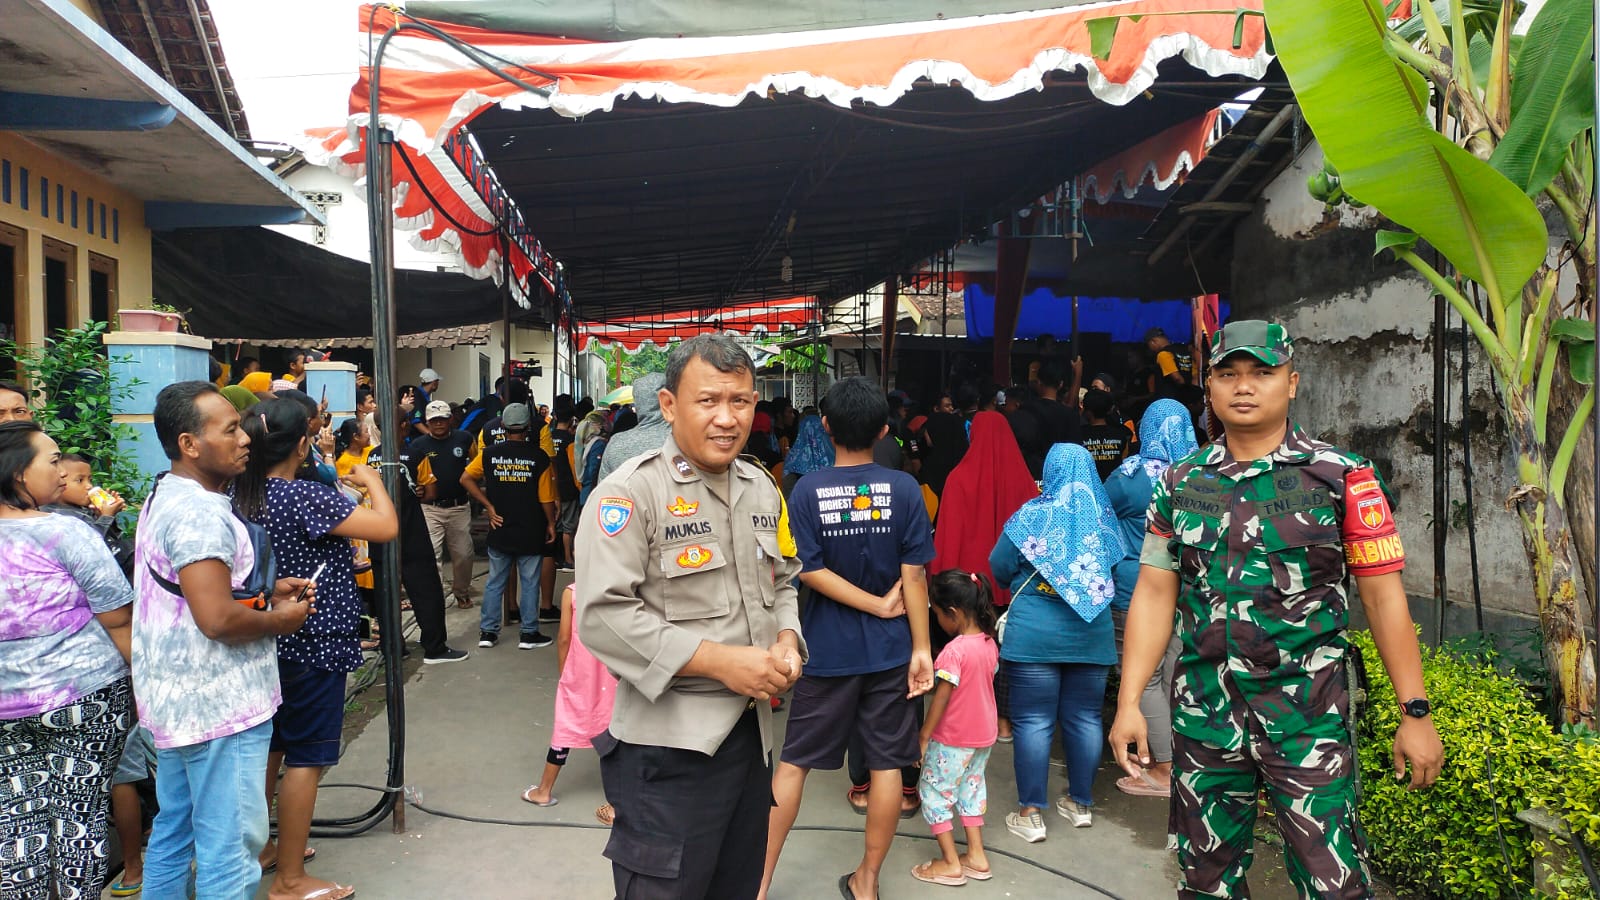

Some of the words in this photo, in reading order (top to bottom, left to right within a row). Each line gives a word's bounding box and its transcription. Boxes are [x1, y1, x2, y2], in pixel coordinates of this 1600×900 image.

[816, 486, 856, 498] VISUALIZE
[870, 483, 891, 494] YOUR
[818, 498, 852, 511] HIGHEST
[872, 496, 891, 507] SELF
[1174, 495, 1220, 514] SUDOMO
[752, 515, 777, 528] POLI
[820, 511, 841, 525] THEN
[850, 510, 872, 521] SHOW
[881, 509, 892, 520] UP
[664, 521, 712, 541] MUKLIS
[1343, 534, 1404, 565] BABINS
